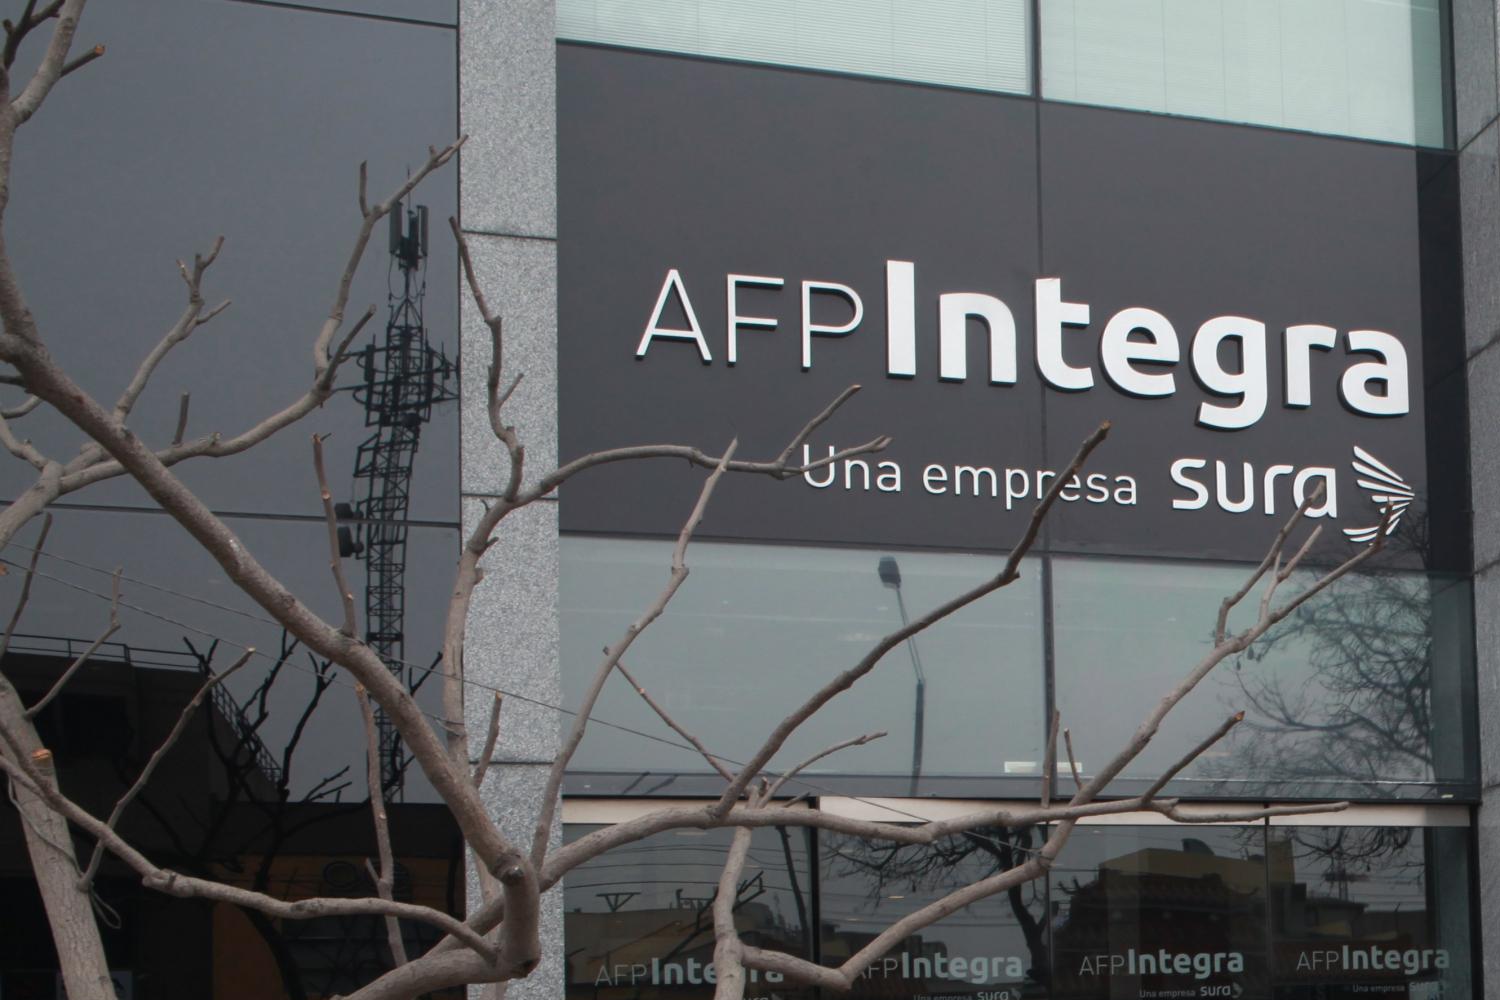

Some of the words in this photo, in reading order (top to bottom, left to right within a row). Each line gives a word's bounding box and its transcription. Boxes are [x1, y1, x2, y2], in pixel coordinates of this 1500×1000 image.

[803, 443, 901, 493] Una
[923, 463, 1137, 510] empresa
[1170, 458, 1337, 518] sura
[1139, 990, 1157, 999] Una
[1158, 990, 1196, 1000] empresa
[1200, 985, 1232, 997] sura
[1352, 984, 1369, 993] Una
[1370, 984, 1405, 995] empresa
